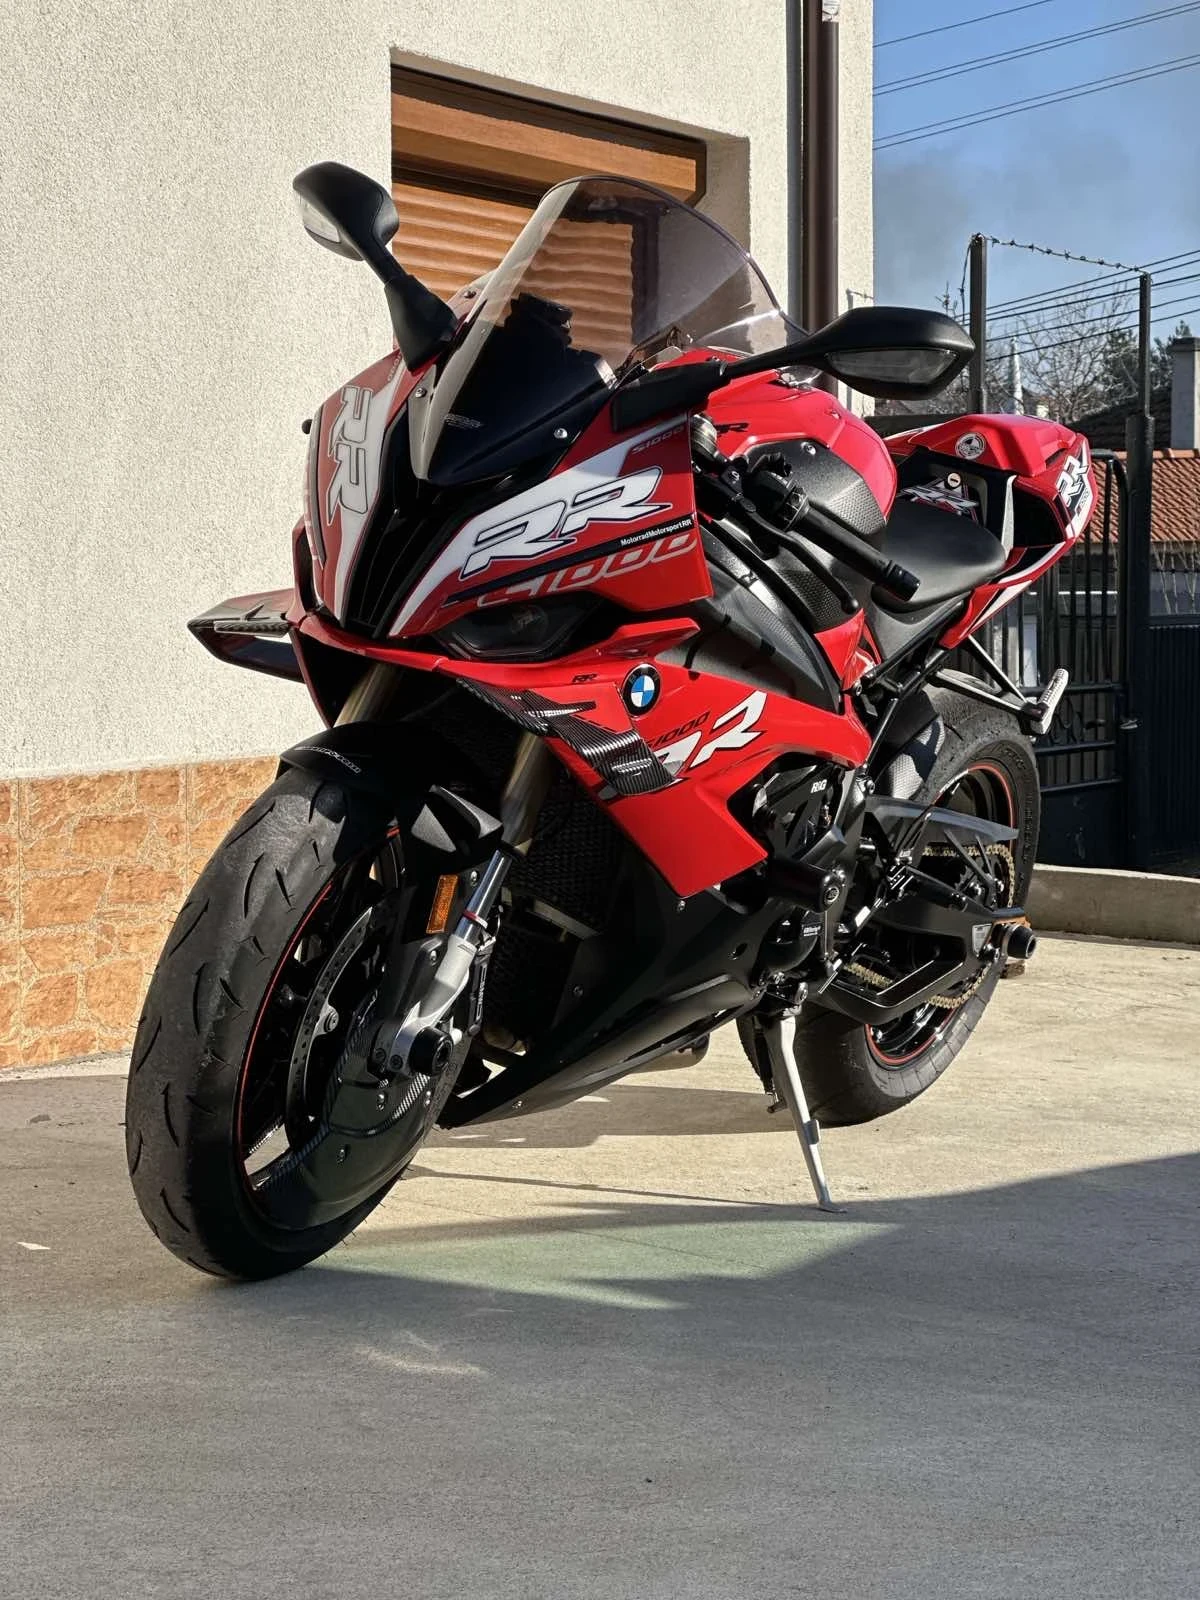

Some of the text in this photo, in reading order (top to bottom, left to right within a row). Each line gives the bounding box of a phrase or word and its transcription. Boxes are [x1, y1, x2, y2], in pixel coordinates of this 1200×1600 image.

[327, 385, 373, 525] RR
[1055, 455, 1089, 507] RR
[459, 466, 673, 580] RR
